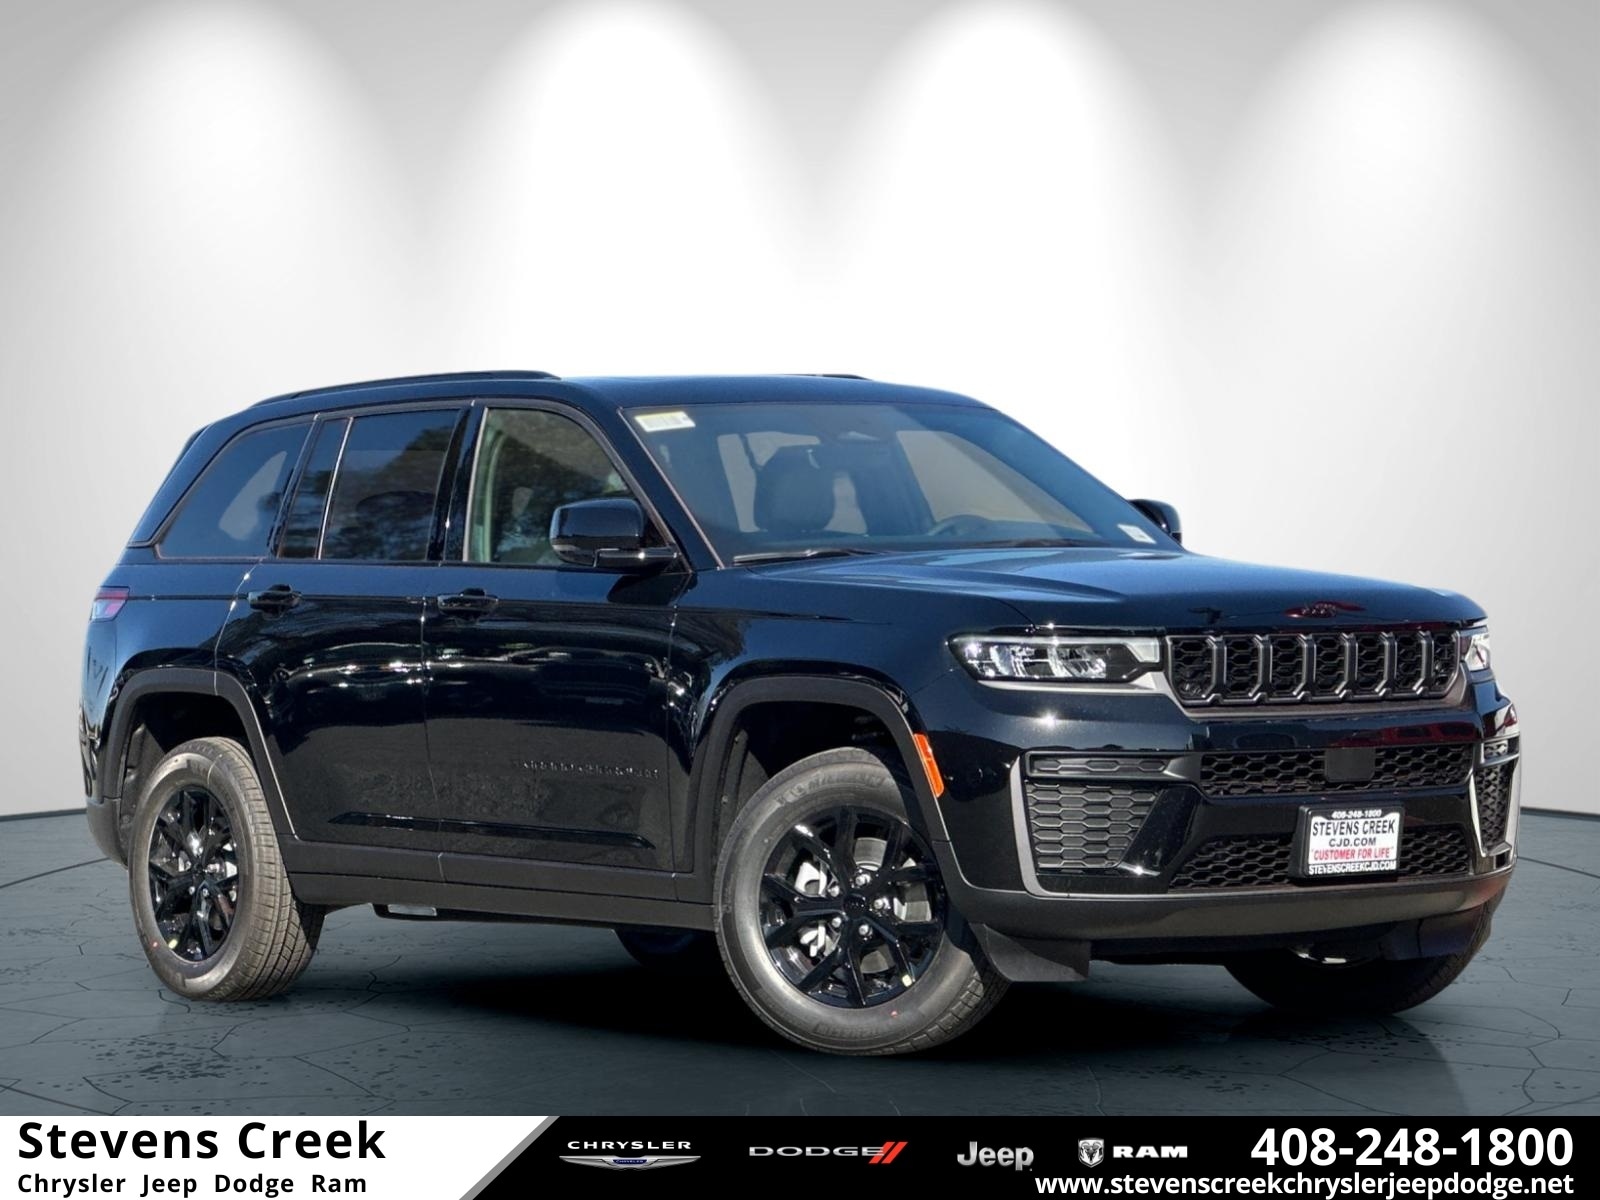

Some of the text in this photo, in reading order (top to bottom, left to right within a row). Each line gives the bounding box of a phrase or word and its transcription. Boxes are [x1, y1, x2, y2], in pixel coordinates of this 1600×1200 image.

[1312, 819, 1396, 836] STEVENS CREEK
[1328, 837, 1377, 847] CJD.COM
[1357, 849, 1373, 859] FOR
